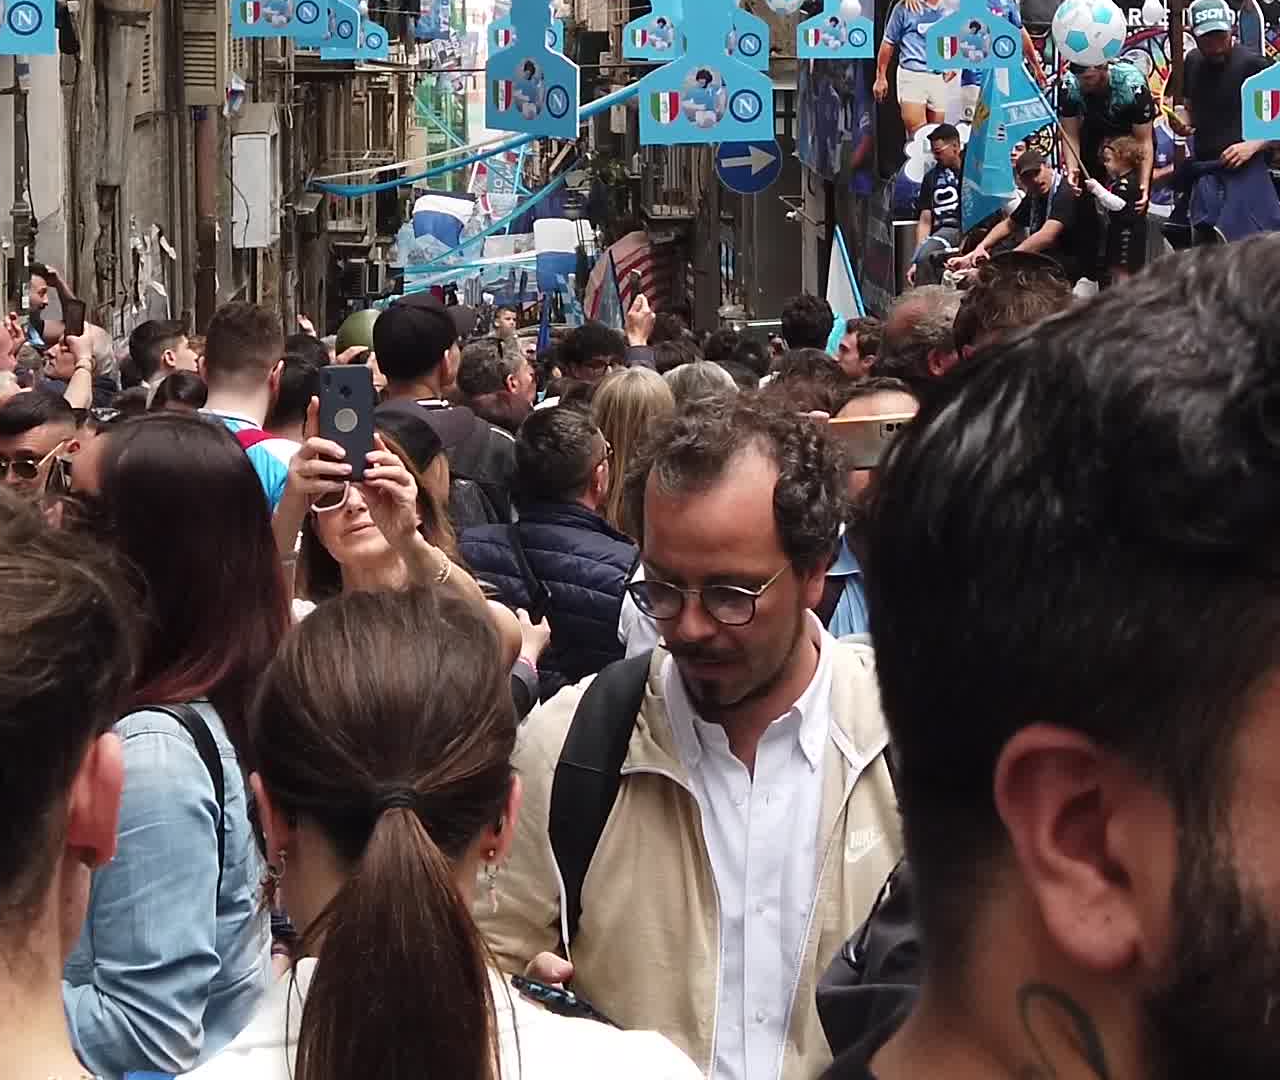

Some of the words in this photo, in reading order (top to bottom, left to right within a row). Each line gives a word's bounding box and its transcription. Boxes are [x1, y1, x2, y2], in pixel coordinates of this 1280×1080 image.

[17, 9, 33, 26] N
[738, 99, 754, 113] N
[933, 186, 960, 217] 10
